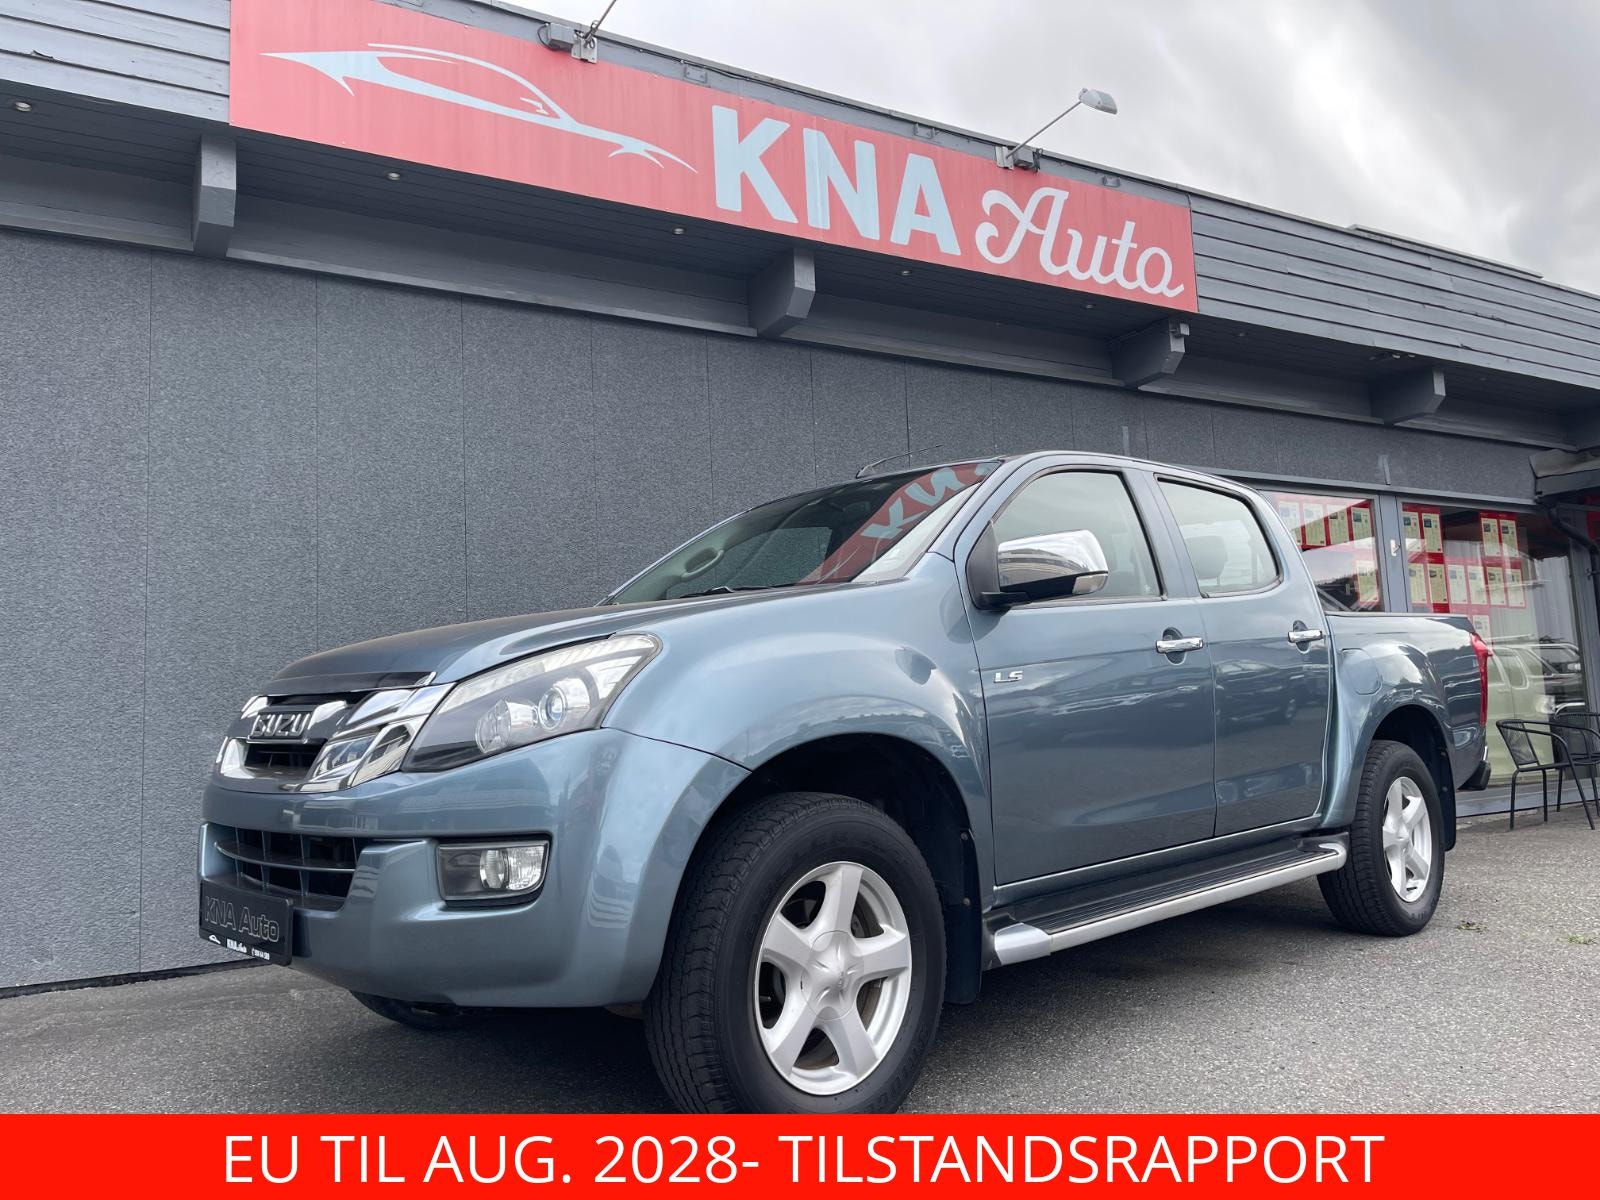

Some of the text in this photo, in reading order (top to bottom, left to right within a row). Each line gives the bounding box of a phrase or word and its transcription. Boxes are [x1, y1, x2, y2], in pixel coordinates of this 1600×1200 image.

[712, 104, 1185, 298] KNA Auto
[994, 670, 1023, 683] LS
[205, 895, 280, 942] KNA Auto
